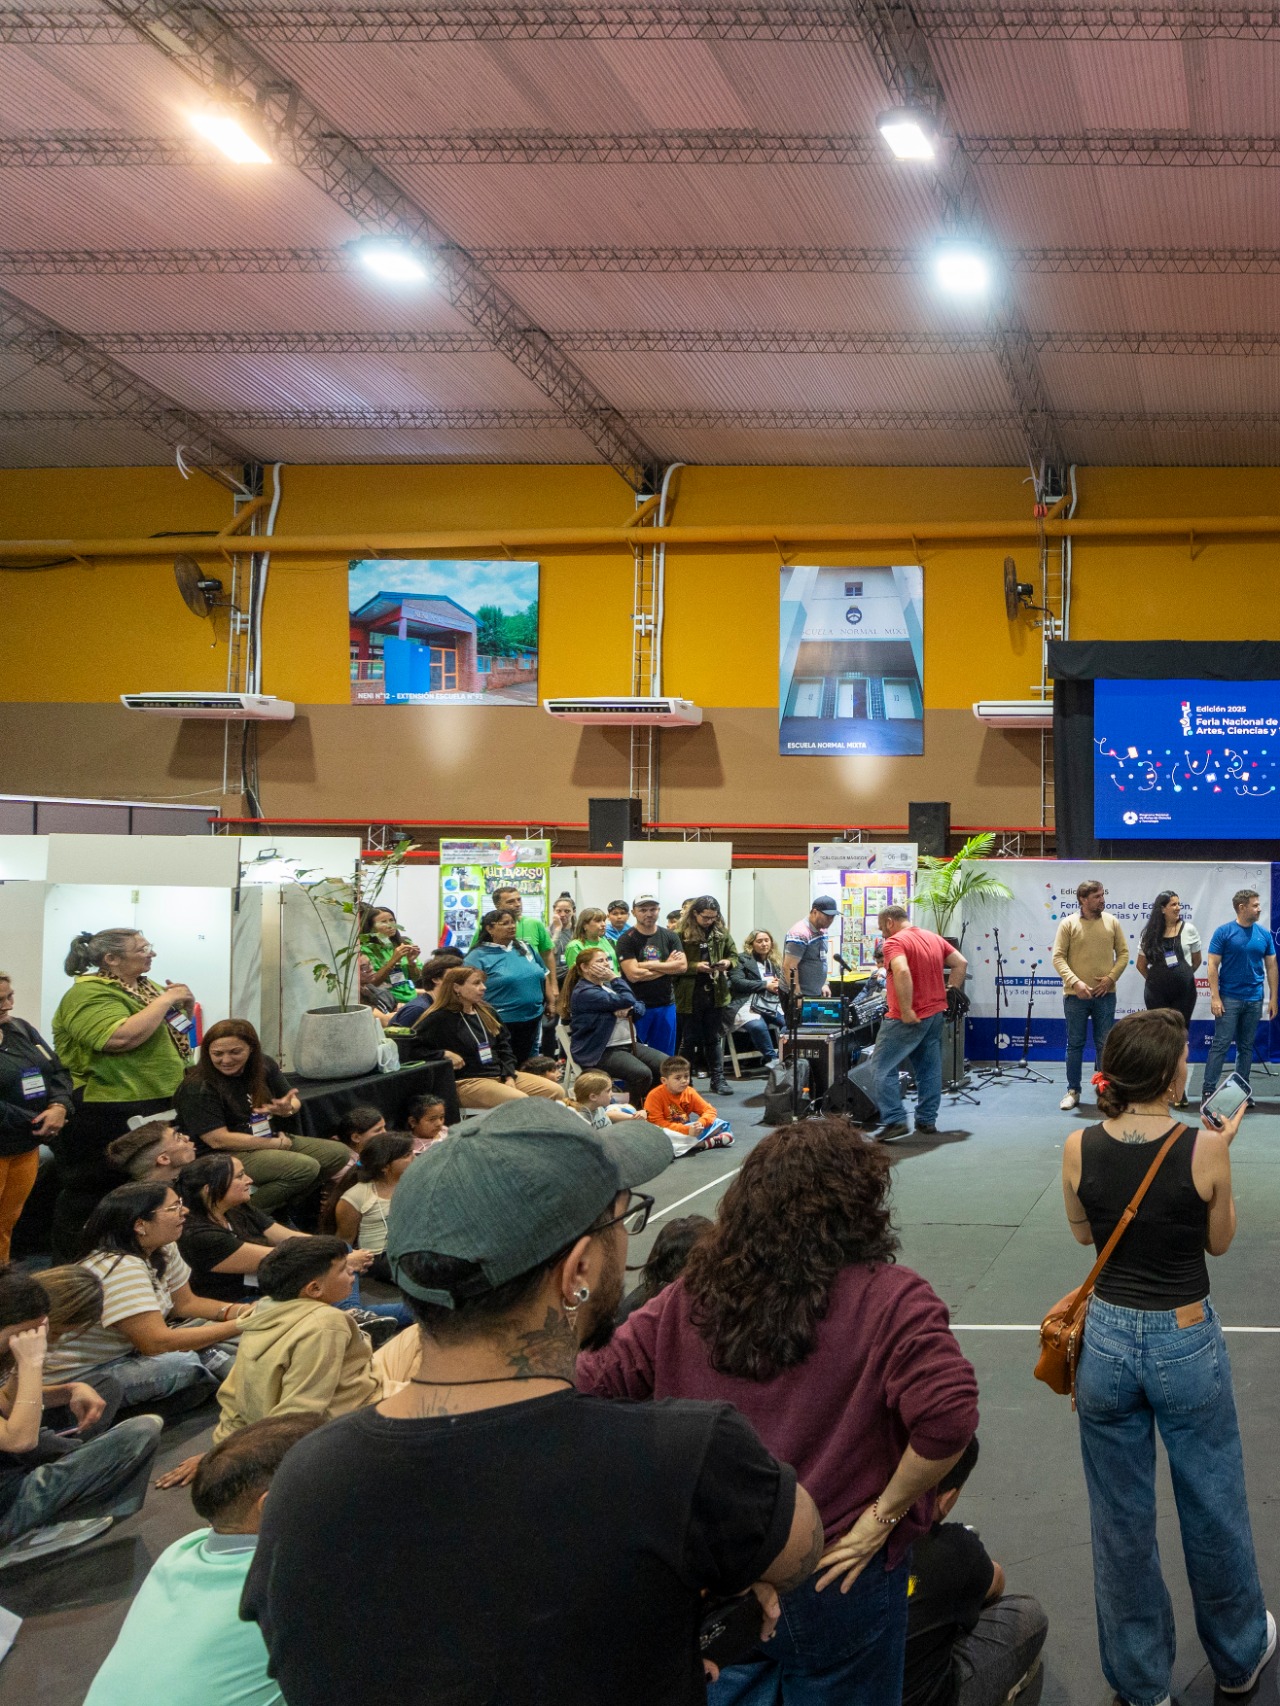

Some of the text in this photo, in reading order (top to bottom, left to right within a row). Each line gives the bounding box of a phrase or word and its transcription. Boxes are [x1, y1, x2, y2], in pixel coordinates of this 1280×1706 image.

[358, 692, 374, 700] NENI
[1196, 705, 1226, 713] Edición
[1196, 718, 1220, 726] Feria
[1222, 718, 1264, 726] Nacional
[1265, 718, 1279, 726] de
[1196, 727, 1225, 736] Artes,
[1227, 727, 1269, 735] Ciencias
[1269, 728, 1277, 736] y
[1127, 901, 1140, 910] de
[1132, 913, 1139, 921] y
